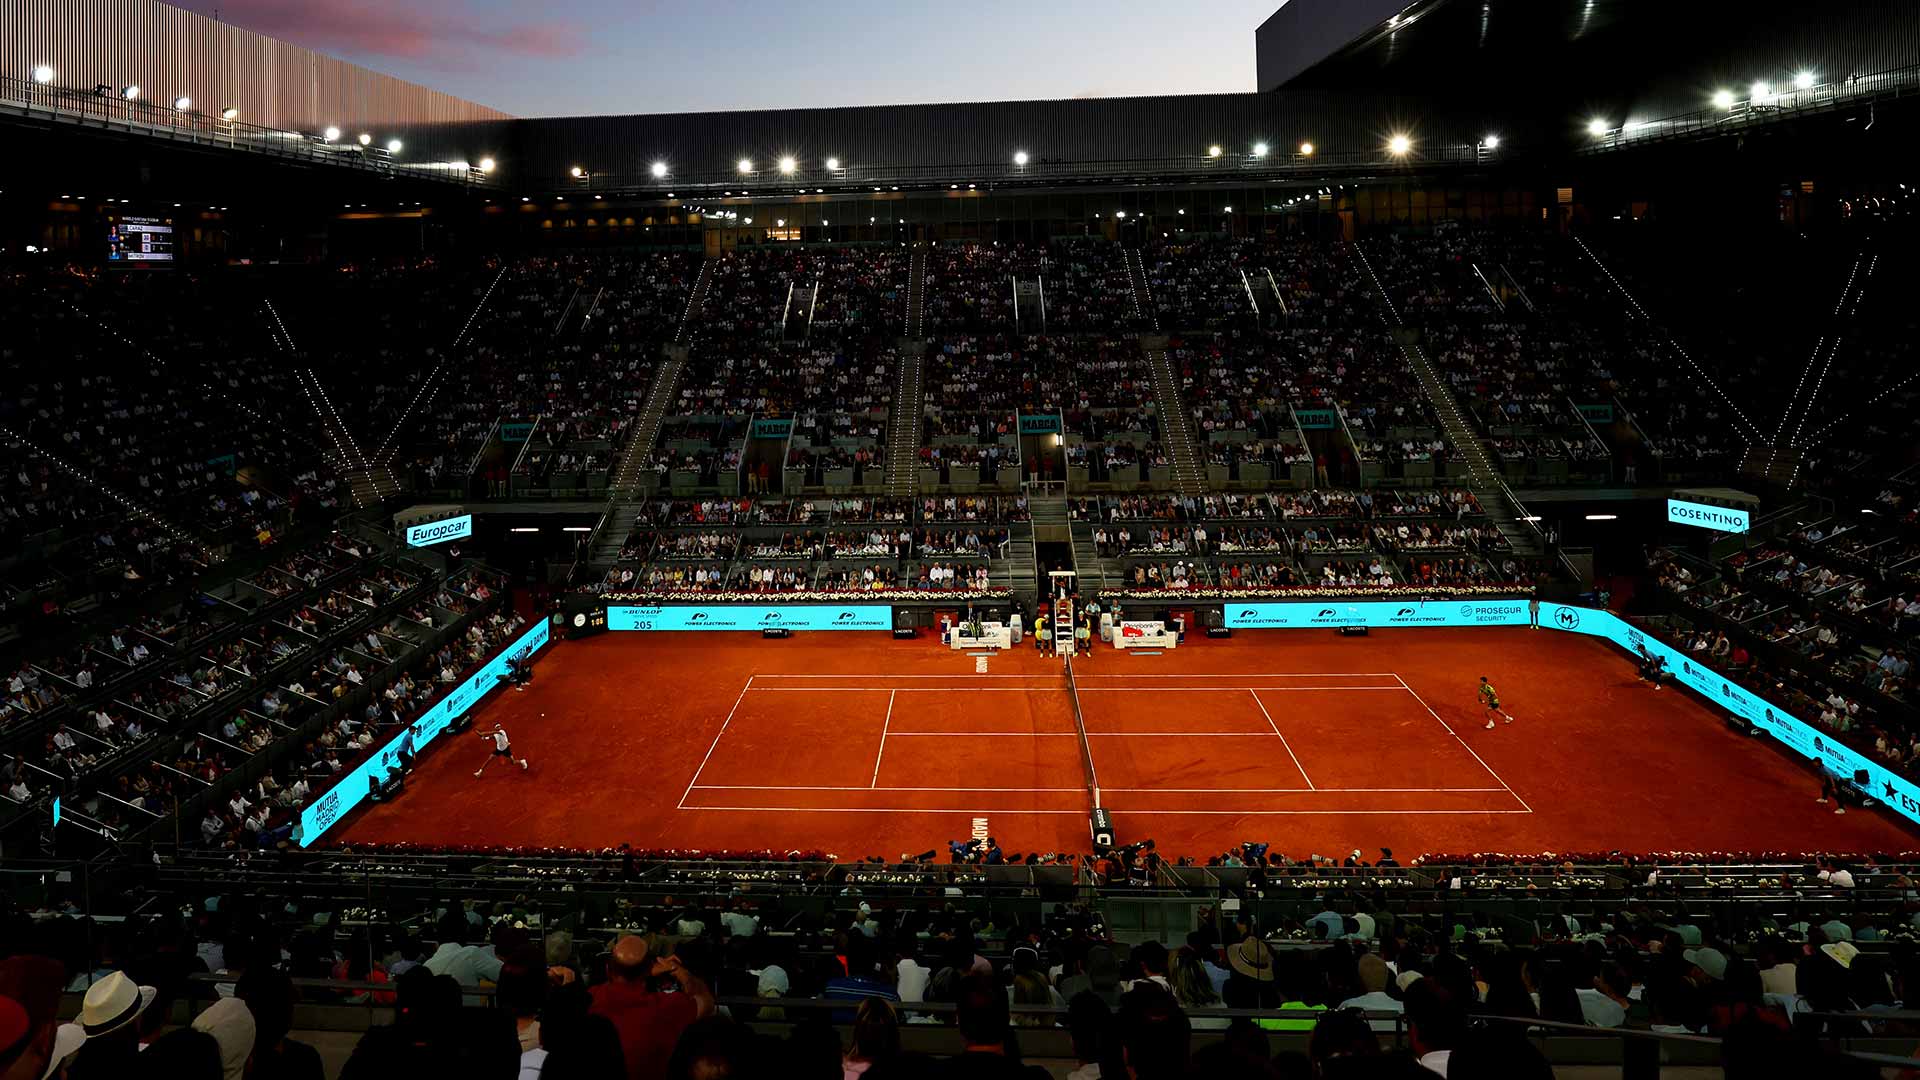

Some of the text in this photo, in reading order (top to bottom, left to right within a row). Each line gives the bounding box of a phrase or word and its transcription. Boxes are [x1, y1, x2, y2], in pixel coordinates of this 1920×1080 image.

[1023, 419, 1057, 430] MARCA
[1671, 507, 1743, 527] COSENTINO
[413, 521, 467, 541] Europcar
[1475, 607, 1521, 615] PROSEGUR
[634, 621, 652, 629] 205
[316, 800, 340, 824] MADRID
[317, 791, 338, 815] MUTUA
[319, 812, 337, 830] OPEN
